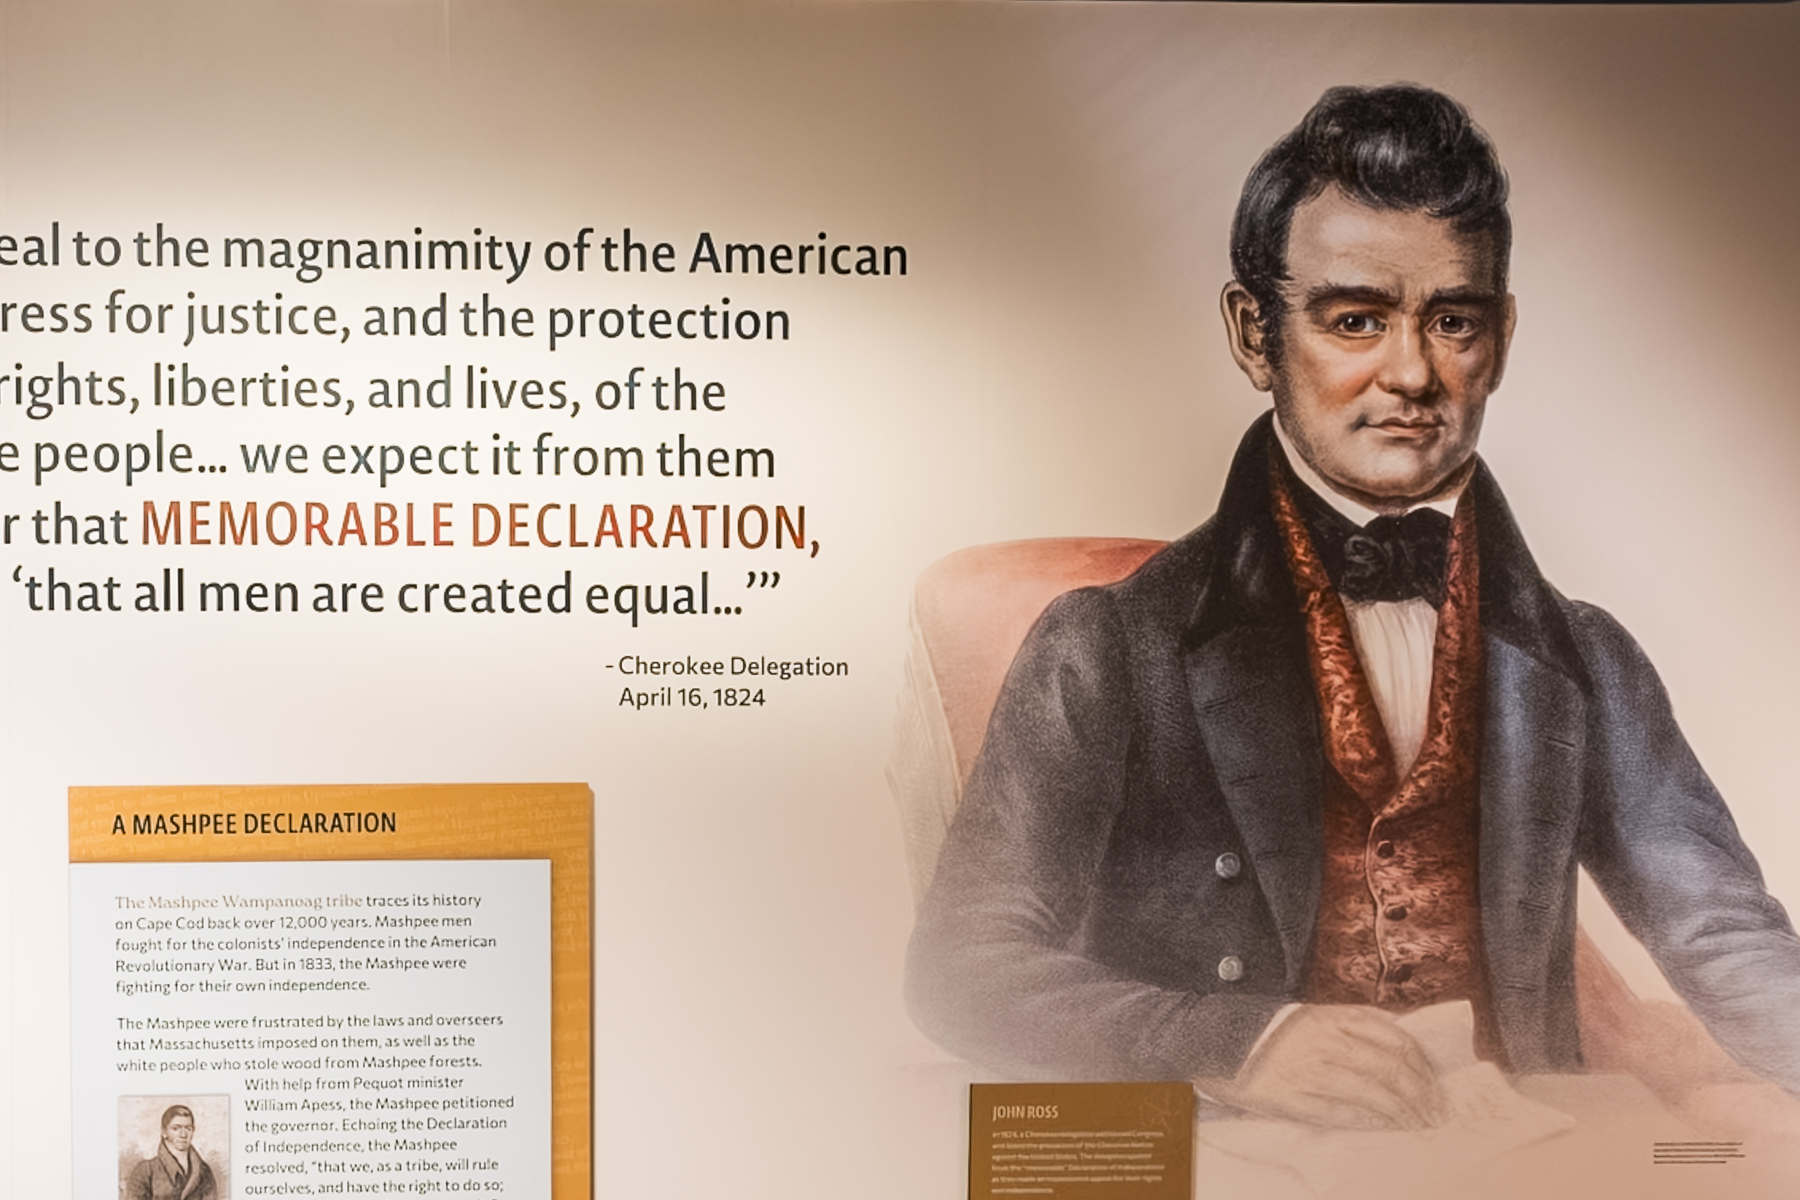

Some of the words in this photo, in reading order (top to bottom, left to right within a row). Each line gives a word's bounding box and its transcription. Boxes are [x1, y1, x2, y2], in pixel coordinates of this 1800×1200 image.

[71, 231, 121, 266] to
[132, 222, 209, 267] the
[223, 225, 532, 284] magnanimity
[543, 226, 594, 272] of
[600, 227, 676, 272] the
[688, 230, 907, 276] American
[104, 288, 174, 334] for
[182, 291, 350, 348] justice,
[362, 291, 447, 336] and
[458, 292, 534, 337] the
[548, 295, 790, 353] protection
[153, 362, 354, 415] liberties,
[367, 364, 451, 408] and
[466, 364, 580, 418] lives,
[595, 366, 644, 411] of
[653, 366, 726, 411] the
[239, 444, 308, 473] we
[322, 440, 480, 488] expect
[491, 432, 522, 475] it
[532, 431, 644, 476] from
[655, 433, 774, 478] them
[30, 500, 129, 545] that
[141, 500, 454, 546] MEMORABLE
[472, 502, 820, 558] DECLARATION,
[134, 567, 184, 612] all
[199, 582, 298, 612] men
[312, 582, 384, 613] are
[397, 569, 572, 614] created
[618, 654, 724, 676] Cherokee
[730, 655, 848, 681] Delegation
[618, 686, 671, 710] April
[676, 687, 708, 709] 16,
[712, 687, 766, 706] 1824
[112, 815, 126, 834] A
[133, 814, 236, 834] MASHPEE
[244, 812, 395, 833] DECLARATION
[114, 895, 145, 909] The
[148, 895, 219, 912] Mashpee
[222, 895, 322, 911] Wampanoag
[326, 894, 362, 908] tribe
[366, 895, 410, 908] traces
[413, 894, 429, 907] its
[433, 894, 482, 909] history
[115, 920, 132, 929] on
[136, 917, 172, 931] Cape
[175, 917, 204, 929] Cod
[207, 917, 240, 928] back
[244, 919, 275, 929] over
[280, 916, 327, 929] 12,000
[330, 919, 371, 929] years.
[374, 915, 438, 929] Mashpee
[441, 917, 471, 926] men
[115, 938, 162, 952] fought
[166, 938, 187, 950] for
[191, 939, 214, 950] the
[287, 937, 385, 951] independence
[388, 936, 400, 947] in
[404, 936, 427, 947] the
[430, 935, 496, 947] American
[244, 1099, 297, 1110] William
[301, 1099, 345, 1112] Apess,
[349, 1099, 372, 1109] the
[375, 1097, 439, 1111] Mashpee
[442, 1096, 514, 1110] petitioned
[992, 1106, 1024, 1120] JOHN
[1027, 1105, 1057, 1117] ROSS
